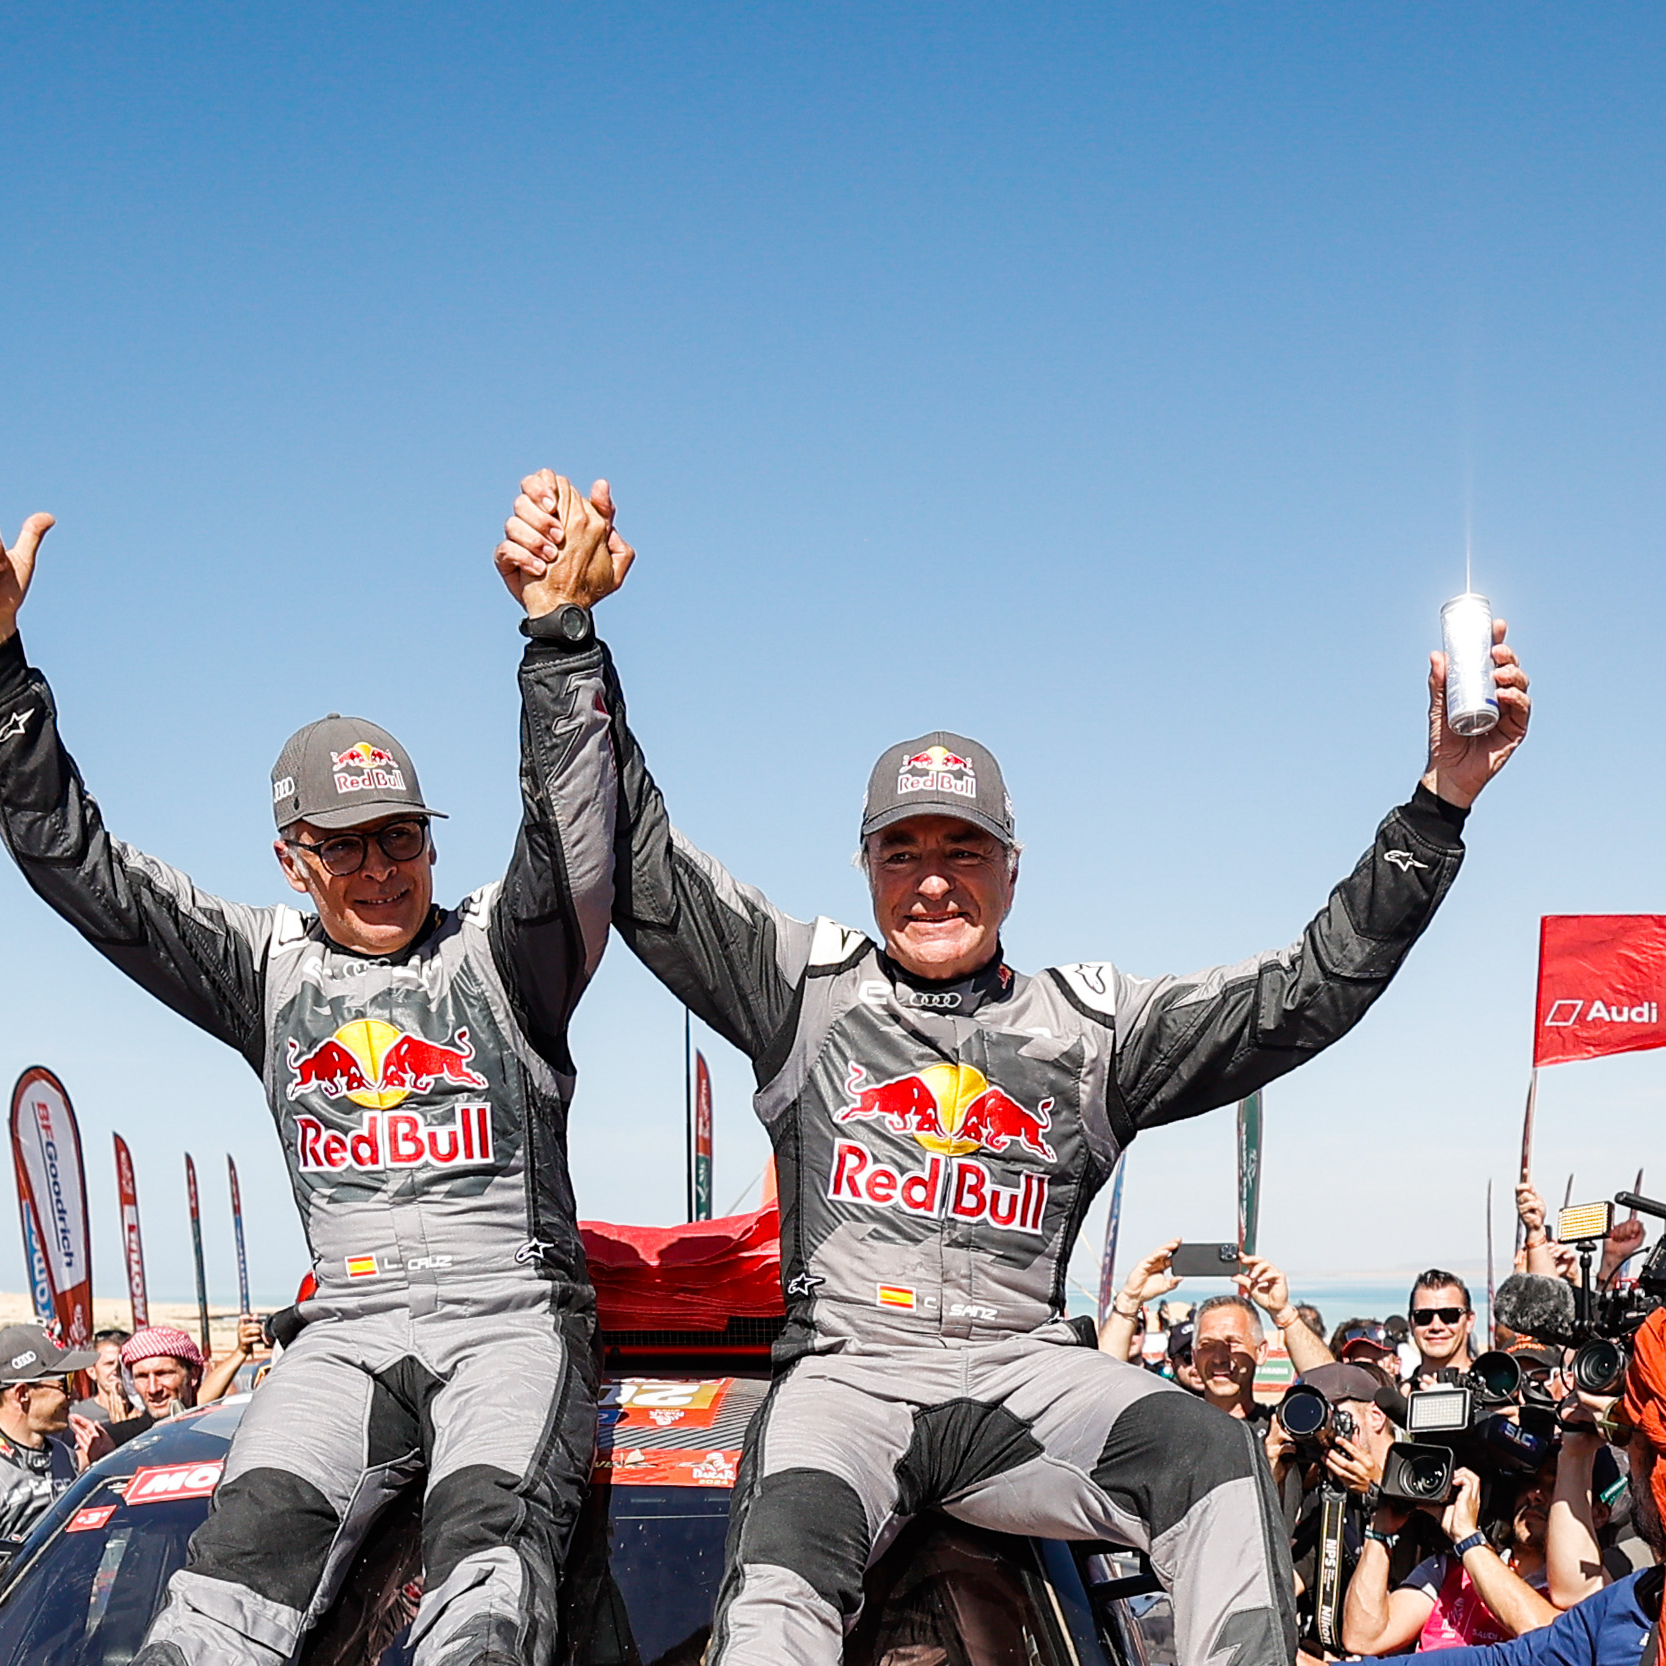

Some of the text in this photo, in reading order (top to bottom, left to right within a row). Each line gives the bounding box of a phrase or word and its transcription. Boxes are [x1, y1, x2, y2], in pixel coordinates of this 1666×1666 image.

[335, 769, 407, 793] Red Bull
[898, 771, 976, 797] Red Bull
[1586, 1000, 1657, 1023] Audi
[296, 1104, 493, 1170] Red Bull
[36, 1102, 75, 1268] BFGoodrich
[830, 1139, 1048, 1233] Red Bull
[949, 1304, 997, 1320] SAINZ
[1323, 1538, 1337, 1569] NPS
[1321, 1605, 1332, 1645] Nikon
